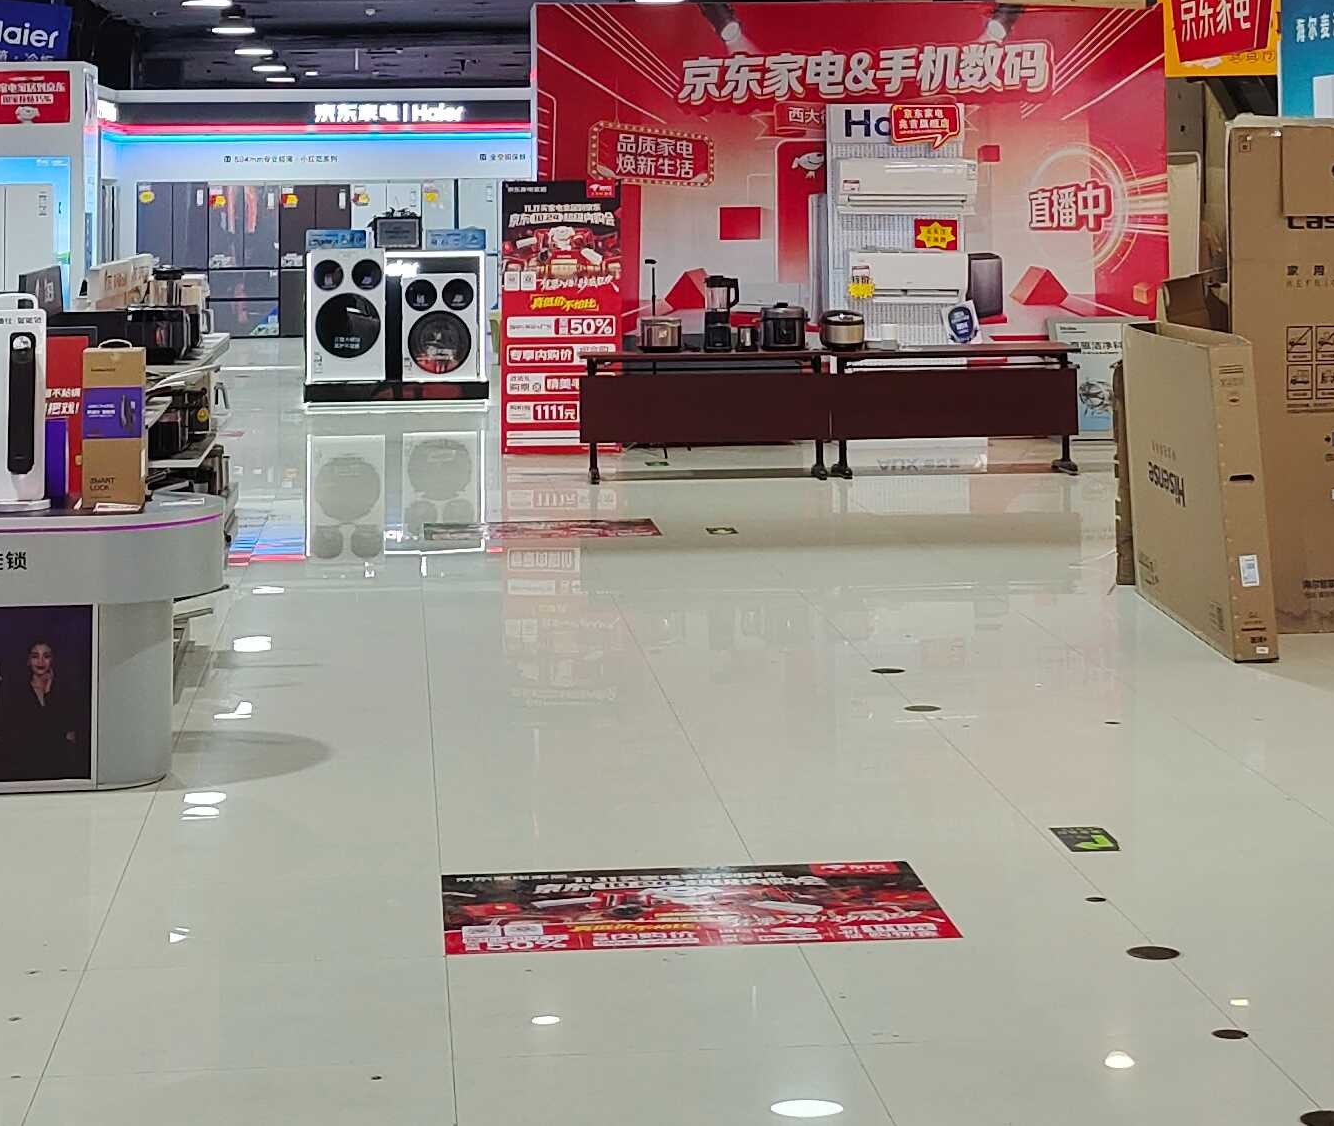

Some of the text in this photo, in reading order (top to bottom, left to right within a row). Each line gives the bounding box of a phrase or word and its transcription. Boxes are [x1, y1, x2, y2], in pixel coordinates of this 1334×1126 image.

[677, 43, 1050, 103] 京东家电&手机数码
[314, 103, 466, 124] 京东家电 Haier
[615, 133, 694, 158] 品质家电
[615, 155, 694, 179] 焕新生活
[1028, 184, 1111, 229] 直播中
[570, 317, 612, 336] 50%
[534, 404, 576, 421] 1111元
[1148, 460, 1186, 507] Hisense
